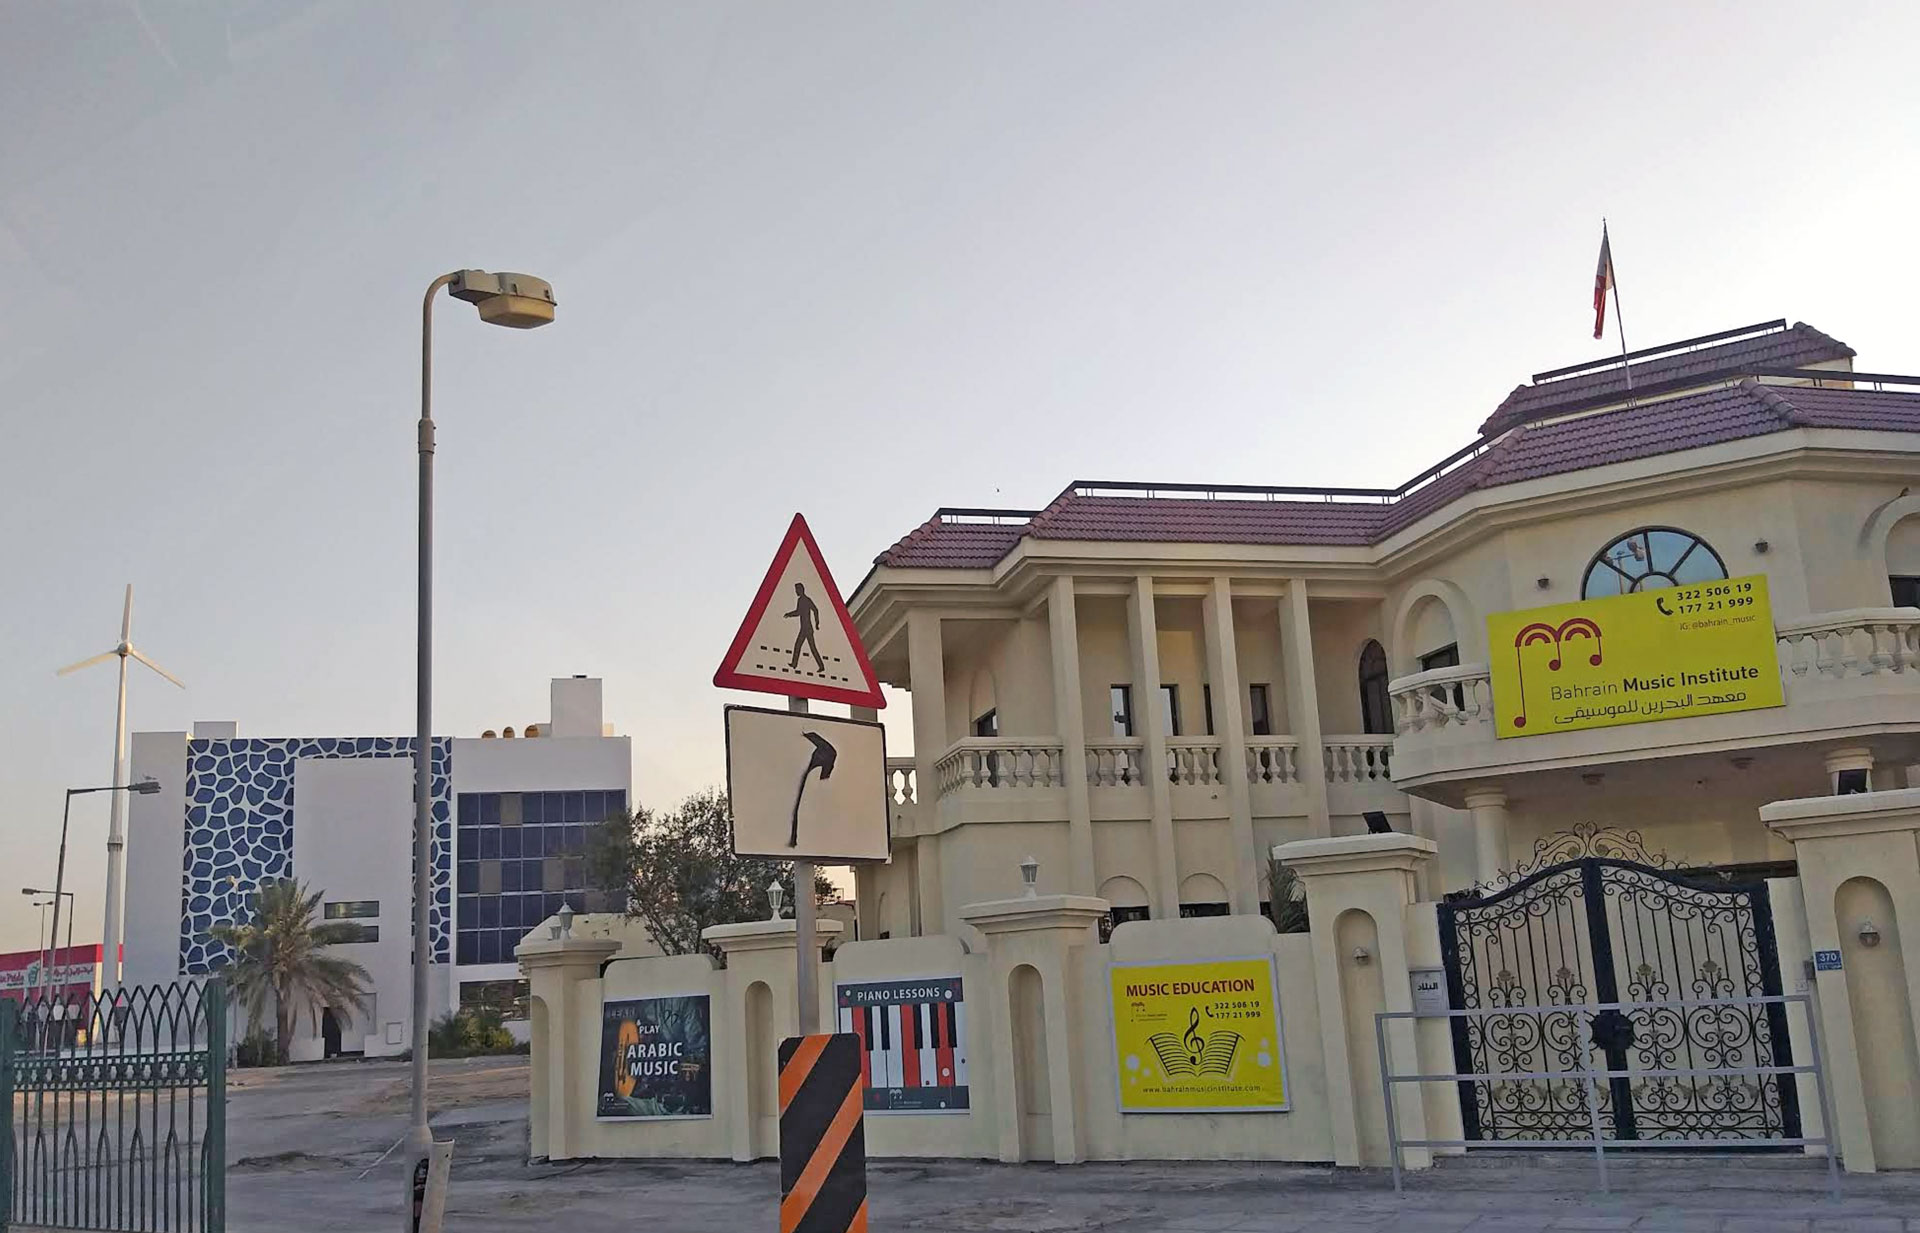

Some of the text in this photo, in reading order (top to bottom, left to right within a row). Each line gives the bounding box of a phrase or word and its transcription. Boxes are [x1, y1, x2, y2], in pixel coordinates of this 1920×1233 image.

[1676, 582, 1752, 601] 322 506 19
[1678, 596, 1754, 614] 177 21 999
[1692, 614, 1756, 630] @bahrain_music
[1551, 666, 1760, 701] Bahrain Music Institute
[1554, 691, 1747, 725] معهد البحرين للموسيقى
[1819, 953, 1837, 961] 370
[857, 987, 940, 1001] PIANO LESSONS
[1126, 979, 1255, 997] MUSIC EDUCATION
[1417, 982, 1438, 991] البلاد
[1214, 1000, 1260, 1010] 322 506 19
[1215, 1011, 1230, 1019] 177
[1245, 1010, 1261, 1018] 999
[639, 1025, 660, 1035] PLAY
[627, 1042, 683, 1058] ARABIC
[630, 1060, 679, 1076] MUSIC
